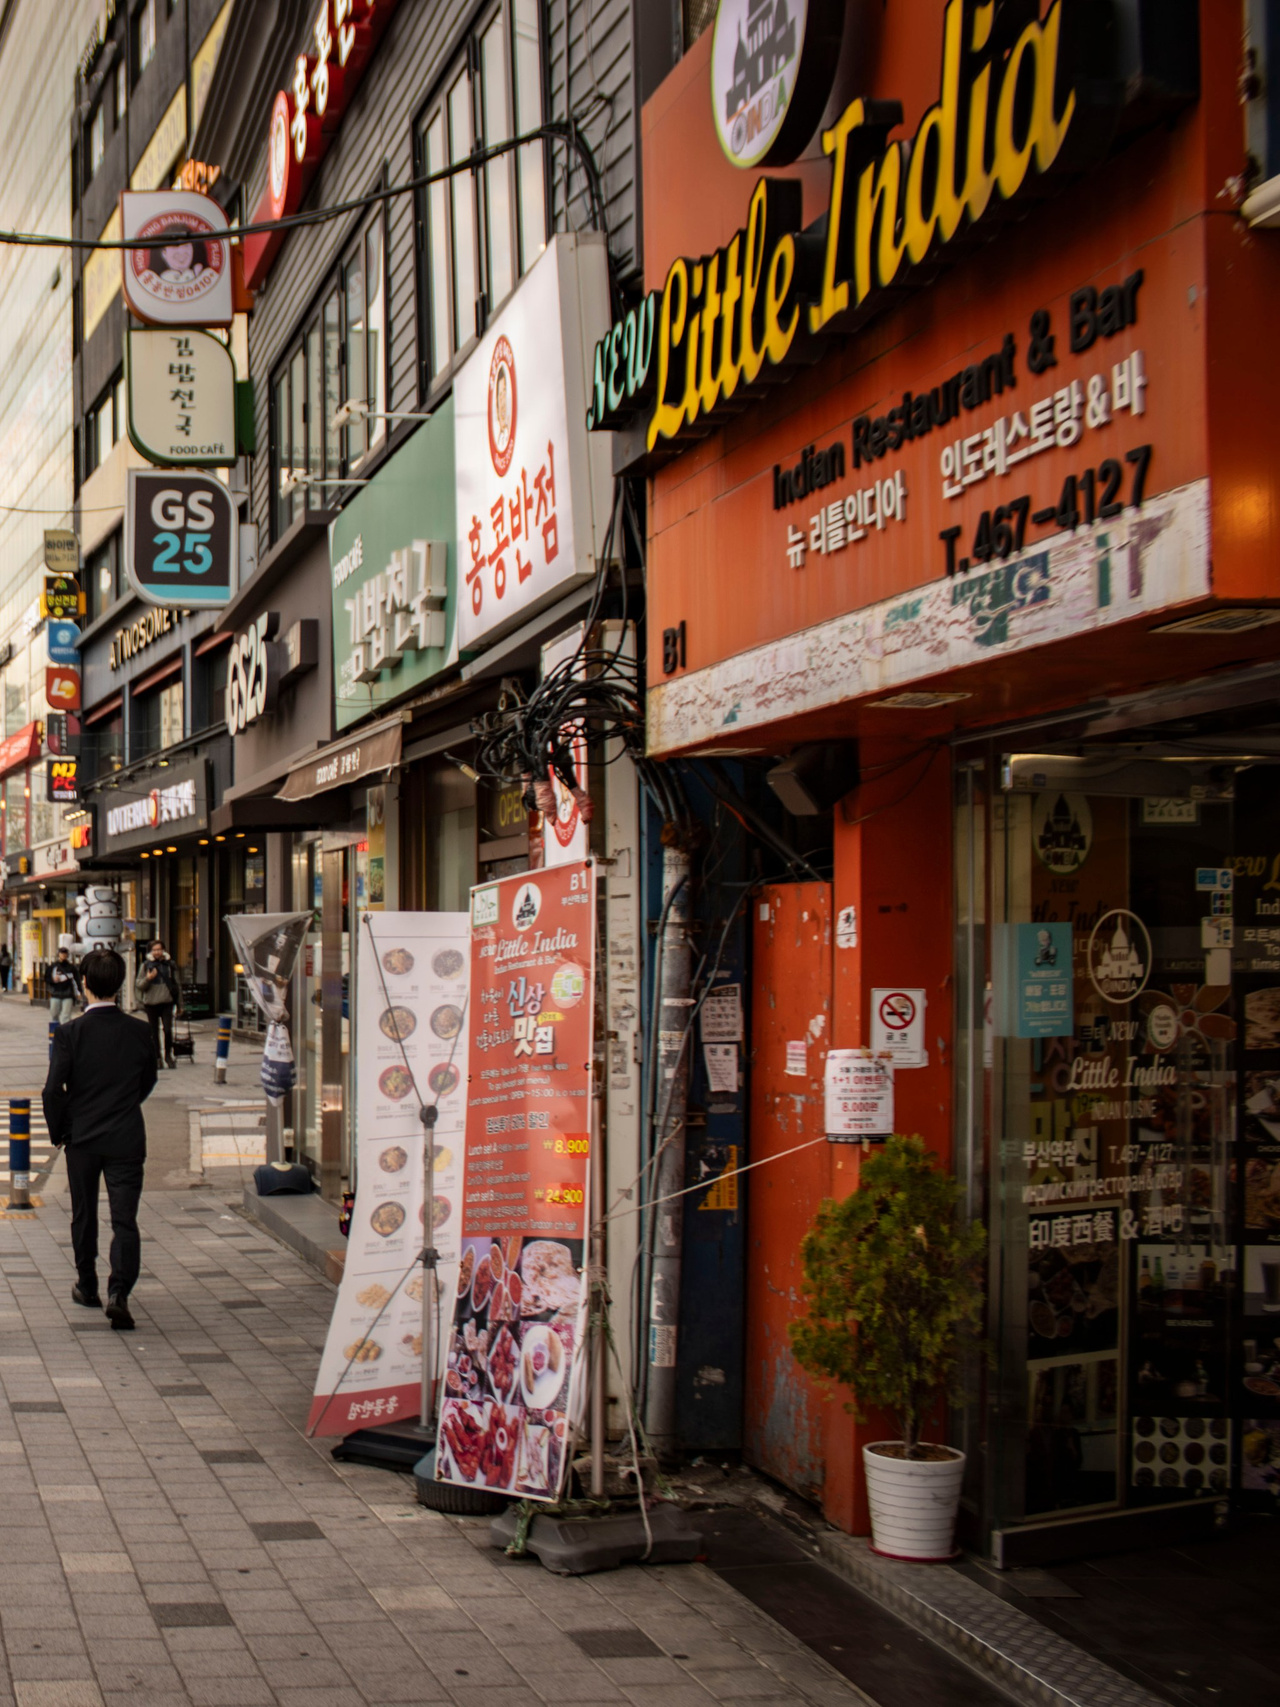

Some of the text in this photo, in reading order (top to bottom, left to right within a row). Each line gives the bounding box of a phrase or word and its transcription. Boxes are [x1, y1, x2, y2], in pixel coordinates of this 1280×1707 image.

[808, 0, 1078, 334] India
[646, 177, 802, 453] Little
[586, 290, 655, 431] NEW
[169, 335, 196, 438] 김밥천국
[773, 269, 1146, 510] Indian Restaurant & Bar
[169, 446, 198, 455] FOOD
[151, 489, 216, 531] GS
[465, 438, 560, 617] 홍콩반점
[152, 533, 213, 575] 25
[116, 606, 171, 664] TWOSOME
[662, 620, 687, 674] B1
[226, 611, 268, 737] GS25
[51, 762, 77, 778] MJ
[52, 777, 76, 790] PC
[107, 797, 152, 836] LOTTERIA
[570, 870, 588, 891] B1
[494, 934, 530, 963] Little
[531, 926, 579, 955] India
[506, 976, 546, 1017] 신상
[513, 1014, 555, 1058] 맛집
[1067, 1053, 1178, 1090] Little India
[1022, 1140, 1079, 1168] 부산역점
[1029, 1204, 1184, 1250] 印度西餐 & 酒吧
